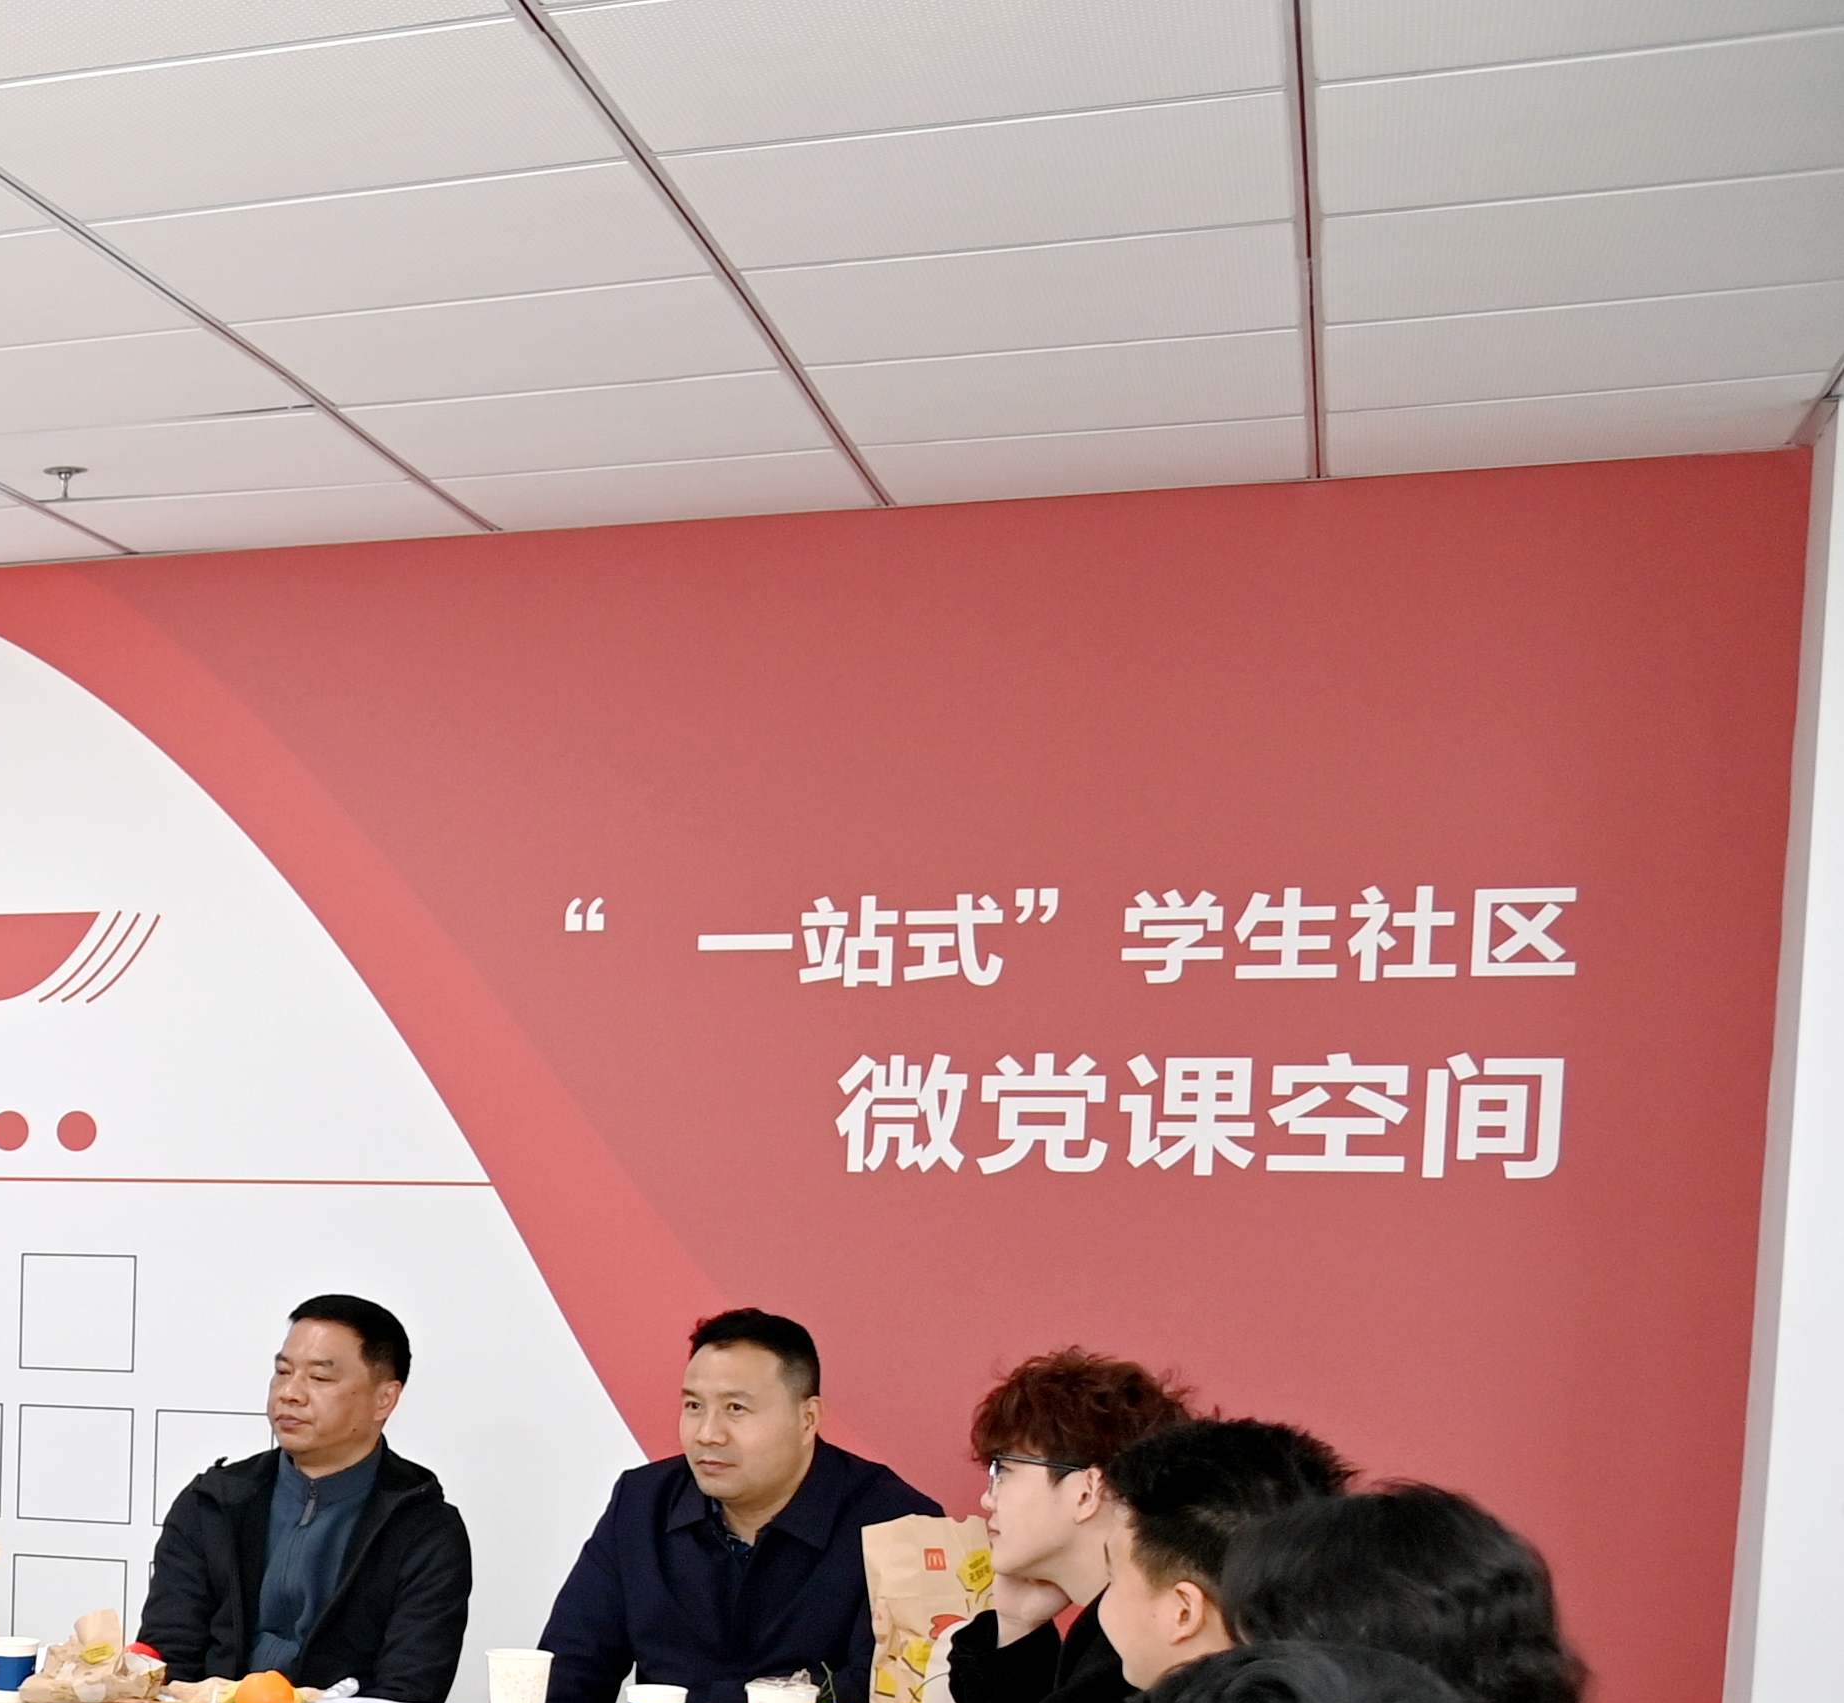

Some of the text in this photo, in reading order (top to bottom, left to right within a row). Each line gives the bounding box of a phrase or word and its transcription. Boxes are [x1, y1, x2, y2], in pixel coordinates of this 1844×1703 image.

[835, 1052, 1565, 1179] 微党课空间
